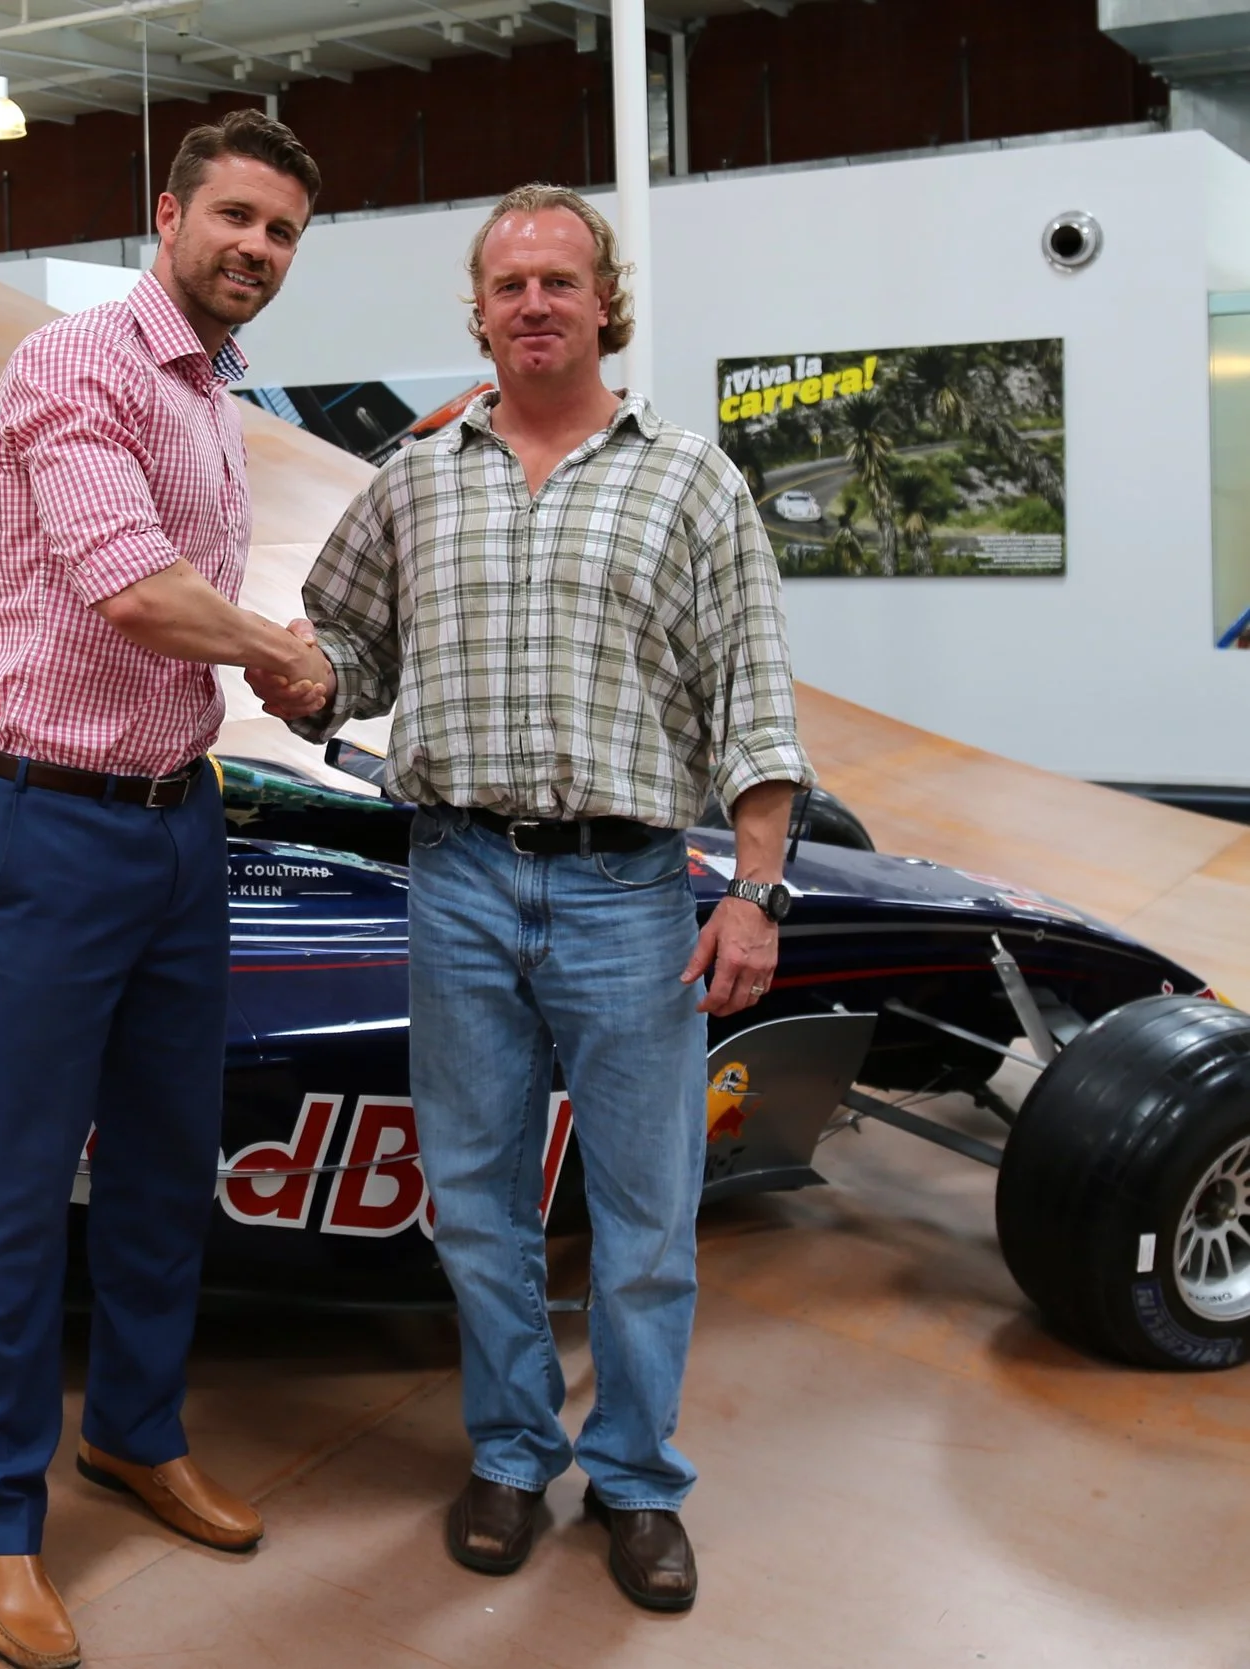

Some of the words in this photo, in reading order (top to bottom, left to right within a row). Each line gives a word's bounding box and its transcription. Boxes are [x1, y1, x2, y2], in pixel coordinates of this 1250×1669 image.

[719, 355, 878, 423] carrera!
[723, 364, 792, 399] ¡Viva
[795, 355, 823, 380] la
[244, 863, 331, 878] COULTHARD
[240, 885, 283, 897] KLIEN
